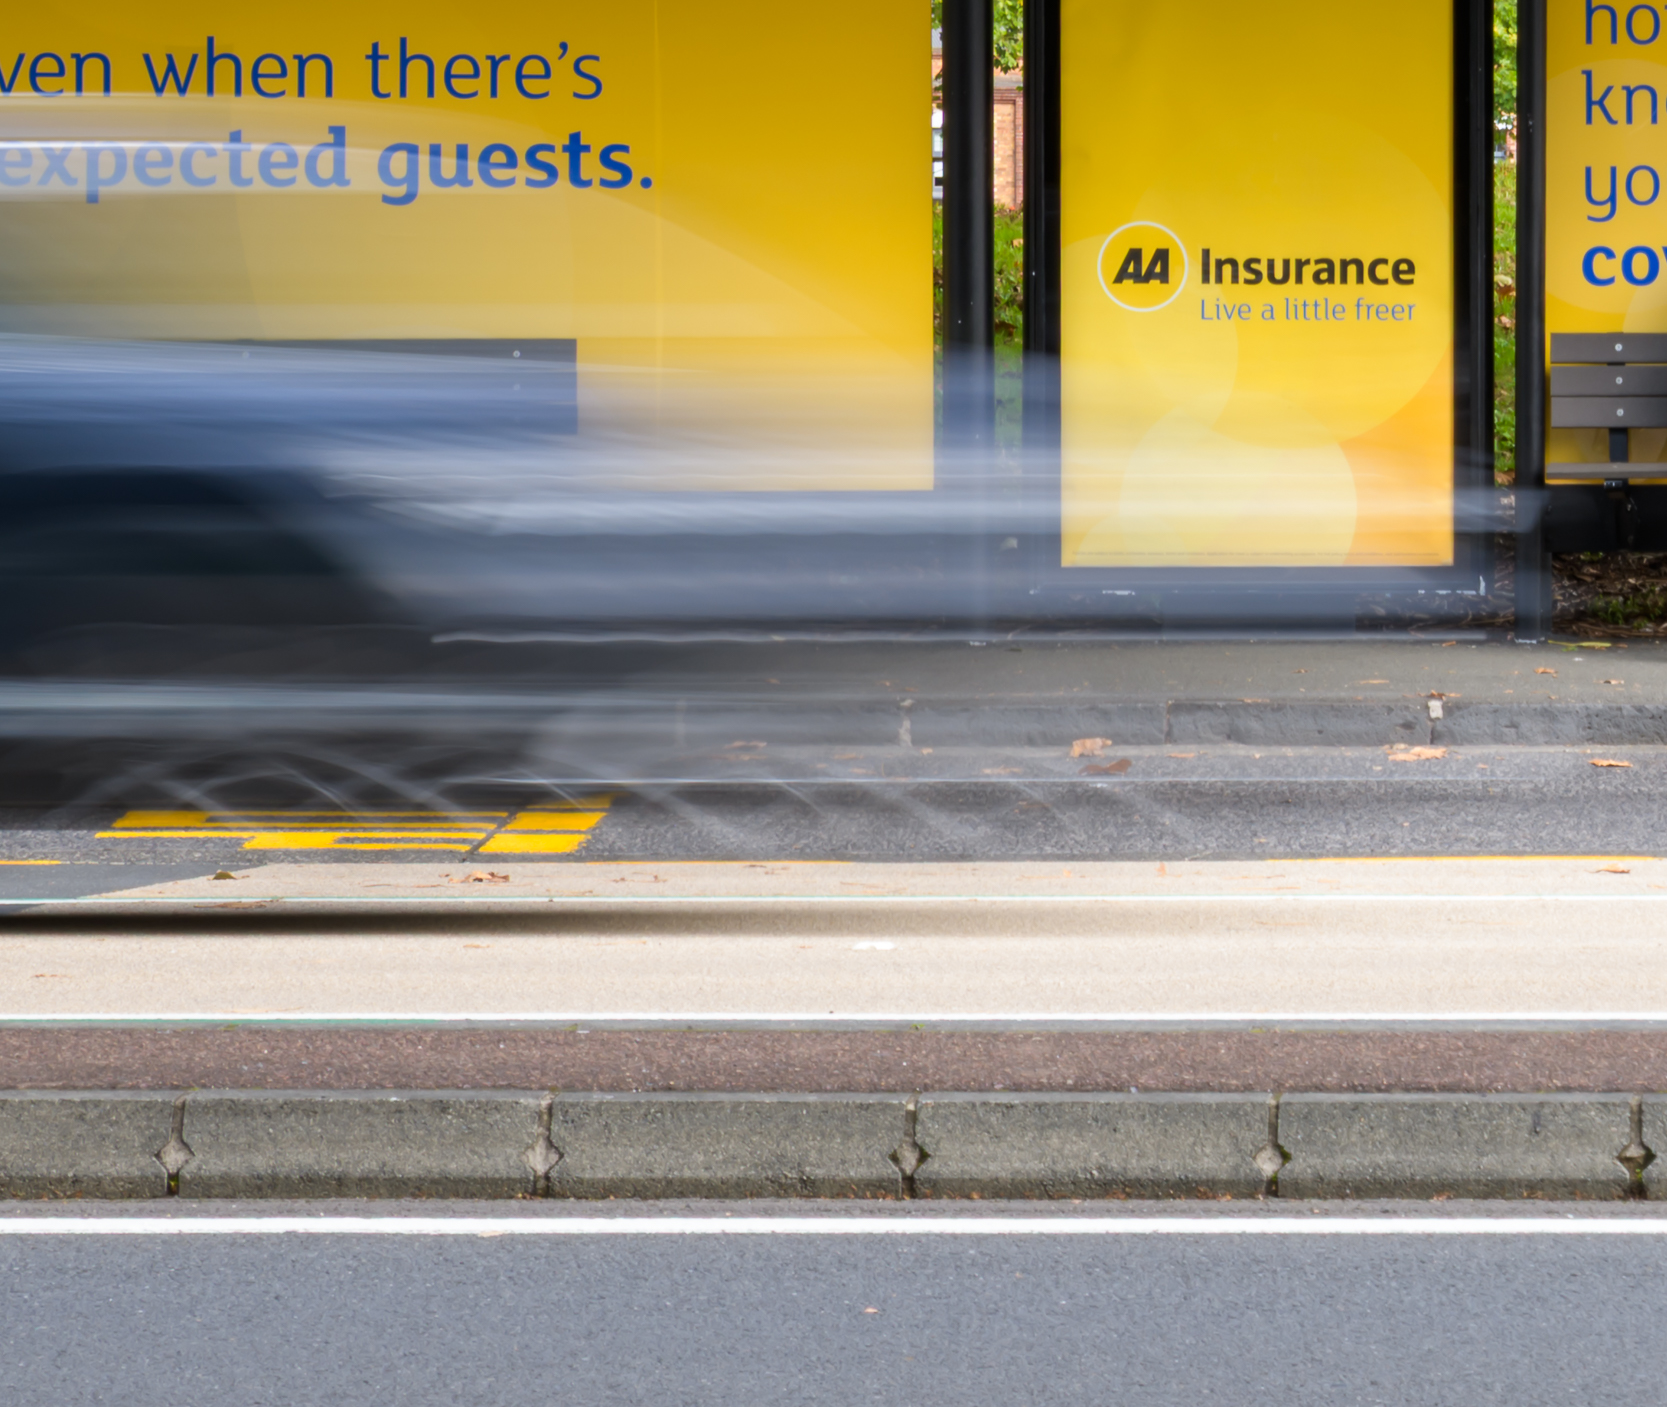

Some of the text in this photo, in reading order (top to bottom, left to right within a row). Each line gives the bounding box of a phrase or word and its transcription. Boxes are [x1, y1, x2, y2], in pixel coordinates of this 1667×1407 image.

[143, 36, 334, 99] when
[365, 37, 604, 100] there's
[377, 131, 653, 207] guests.
[1111, 247, 1417, 286] AA Insurance
[1200, 296, 1417, 322] Live a little freer
